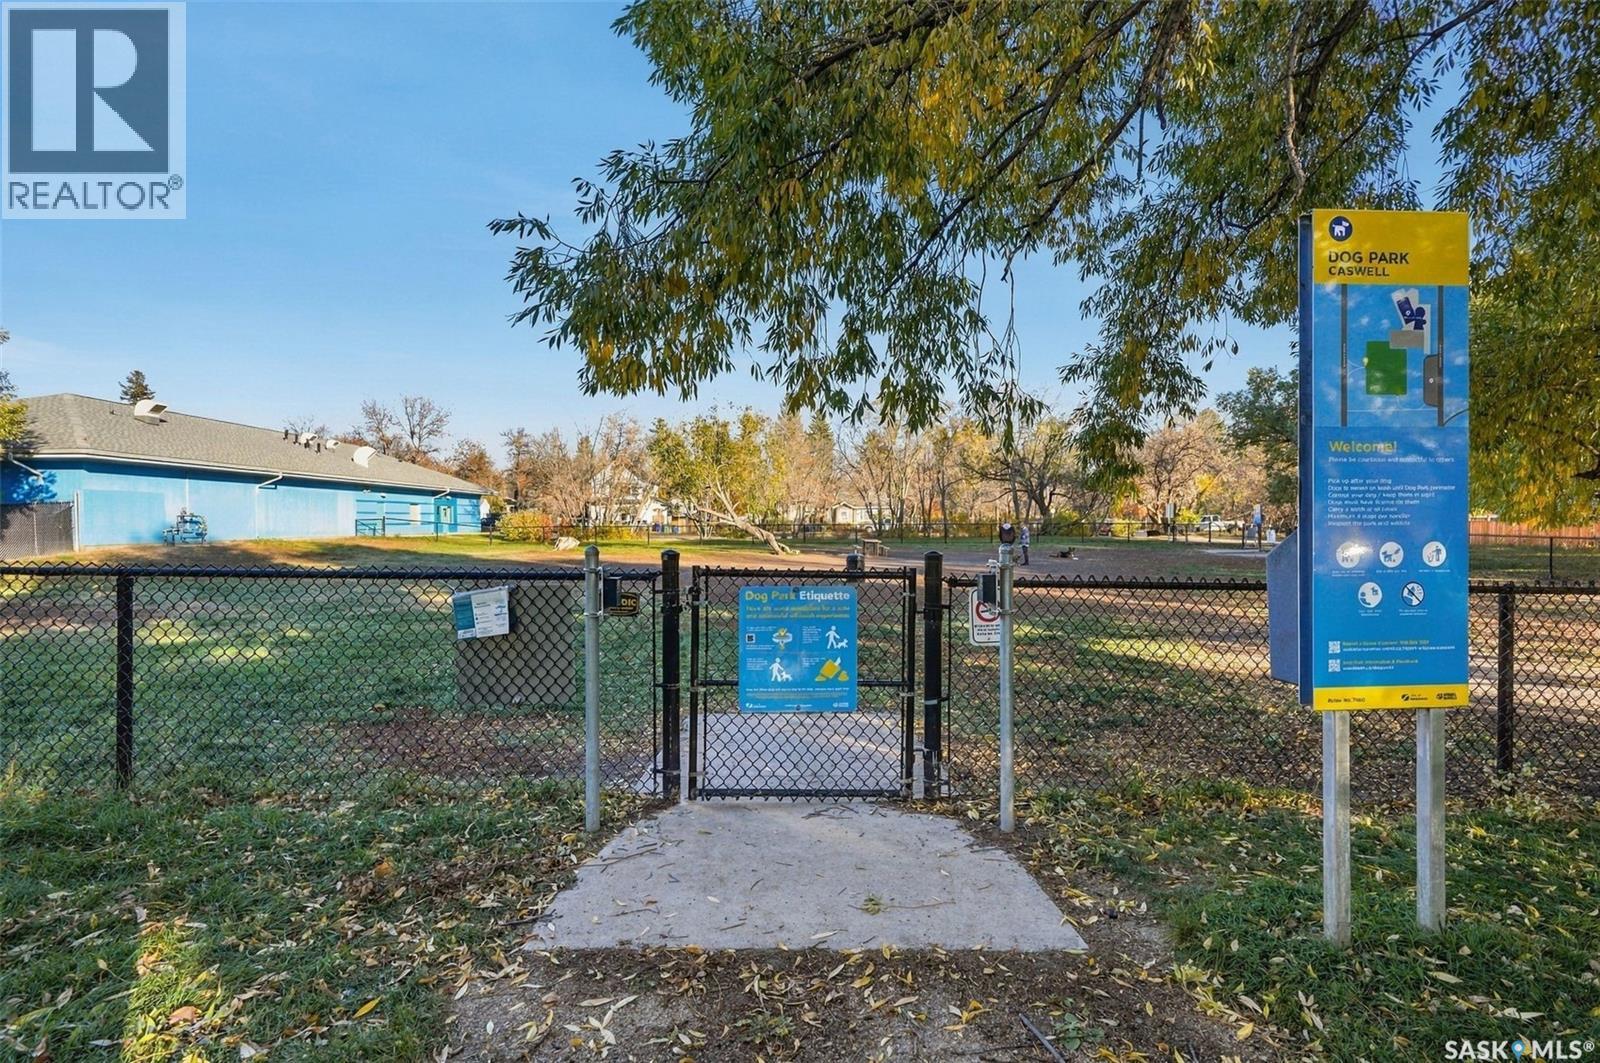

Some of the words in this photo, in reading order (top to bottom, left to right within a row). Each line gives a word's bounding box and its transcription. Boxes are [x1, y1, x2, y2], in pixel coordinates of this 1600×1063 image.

[1329, 251, 1363, 263] DOG
[1369, 252, 1409, 264] PARK
[1329, 266, 1389, 277] CASWELL
[1329, 440, 1397, 453] Welcome!
[746, 590, 768, 603] Dog
[800, 590, 850, 603] Etiquette
